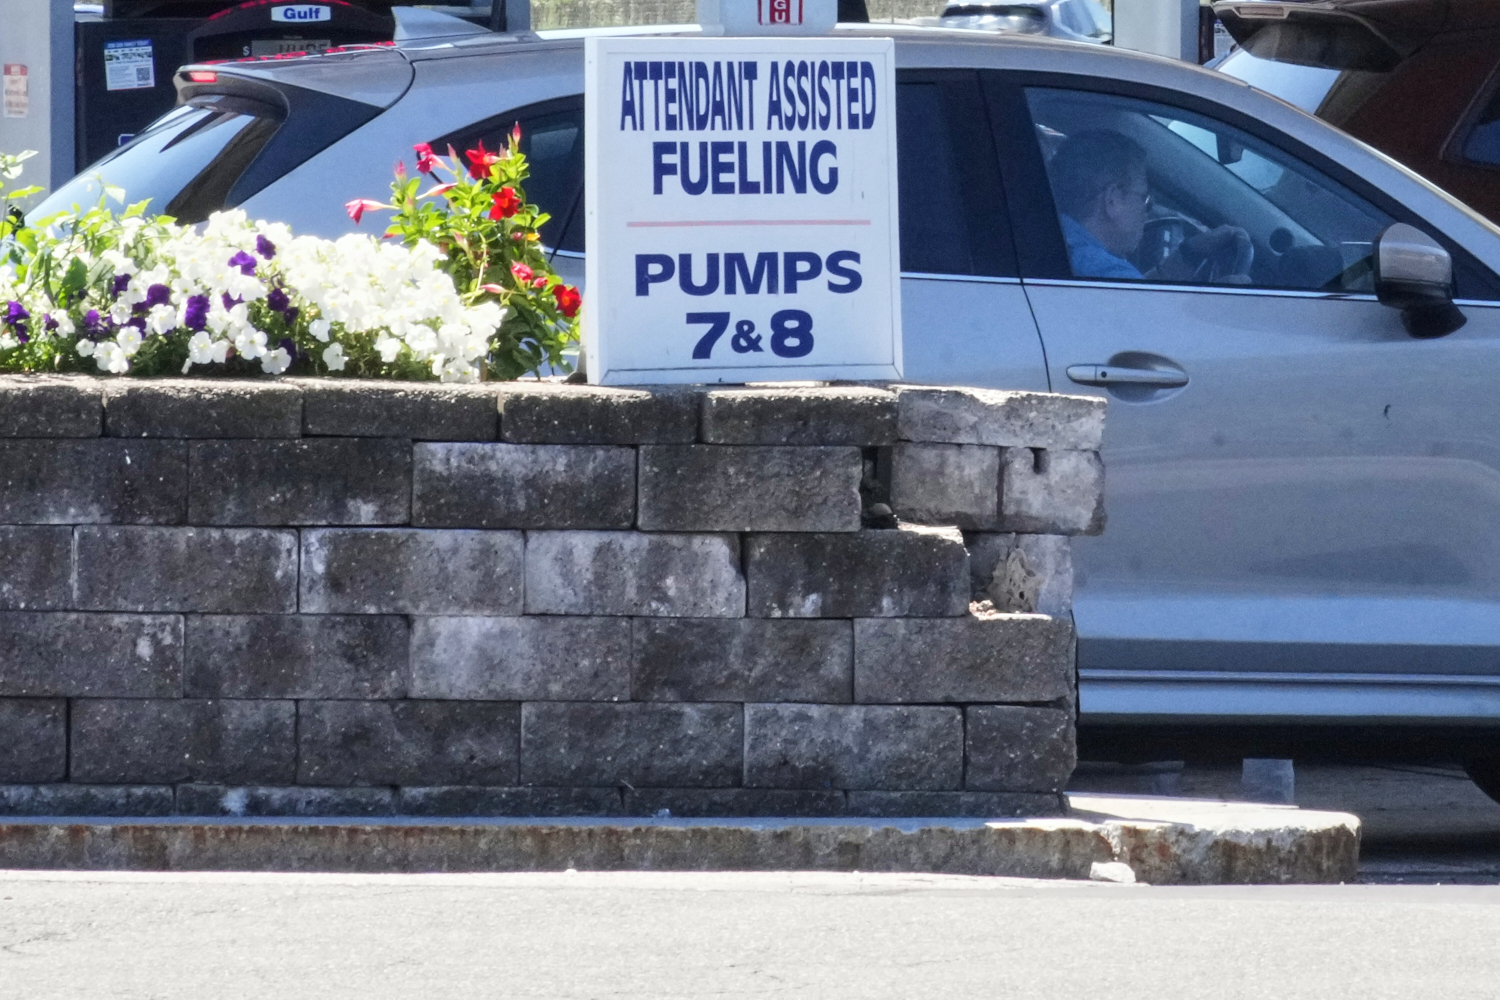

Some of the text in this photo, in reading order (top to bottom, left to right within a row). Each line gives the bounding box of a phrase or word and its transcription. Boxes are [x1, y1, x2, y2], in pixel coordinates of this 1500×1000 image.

[284, 7, 321, 20] Gulf
[620, 60, 877, 131] ATTENDANT ASSISTED
[652, 139, 839, 195] FUELING
[635, 250, 863, 297] PUMPS
